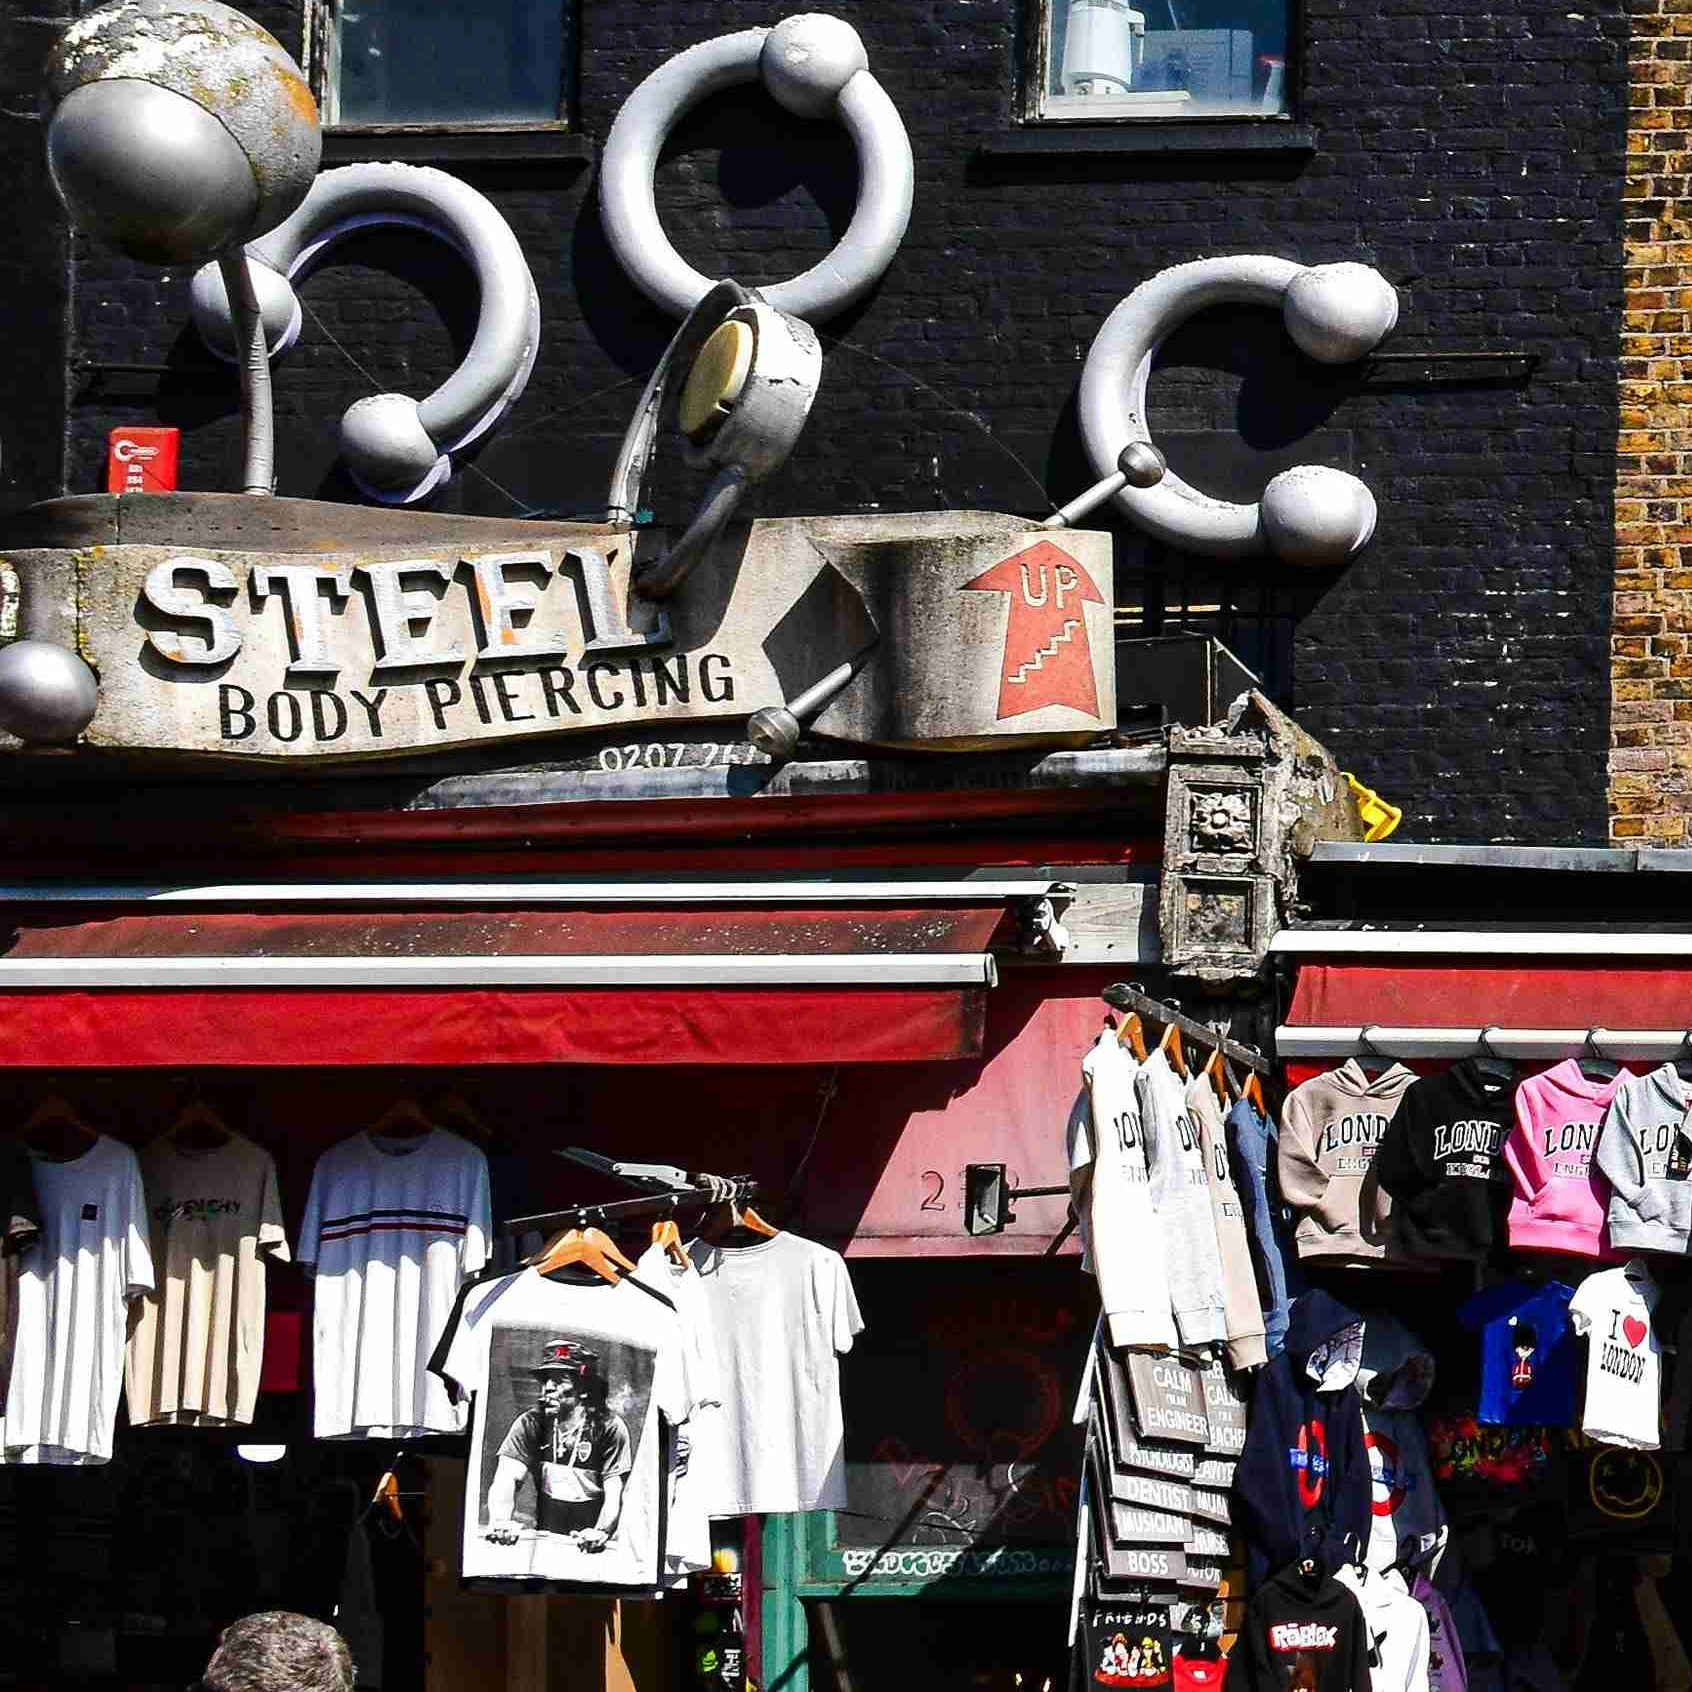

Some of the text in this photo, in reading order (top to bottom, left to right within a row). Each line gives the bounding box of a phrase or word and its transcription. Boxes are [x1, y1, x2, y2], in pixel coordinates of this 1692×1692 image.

[1019, 564, 1078, 608] UP
[138, 546, 672, 683] STEEL
[217, 652, 735, 744] BODY PIERCING
[600, 741, 685, 772] 0207
[1608, 1309, 1621, 1340] I
[1600, 1342, 1647, 1384] LONDON
[1153, 1366, 1192, 1394] CALM
[1147, 1406, 1208, 1437] ENGINEER
[1127, 1475, 1191, 1511] DENTIST
[1121, 1513, 1185, 1536] MUSICIAN
[1128, 1551, 1169, 1575] BOSS
